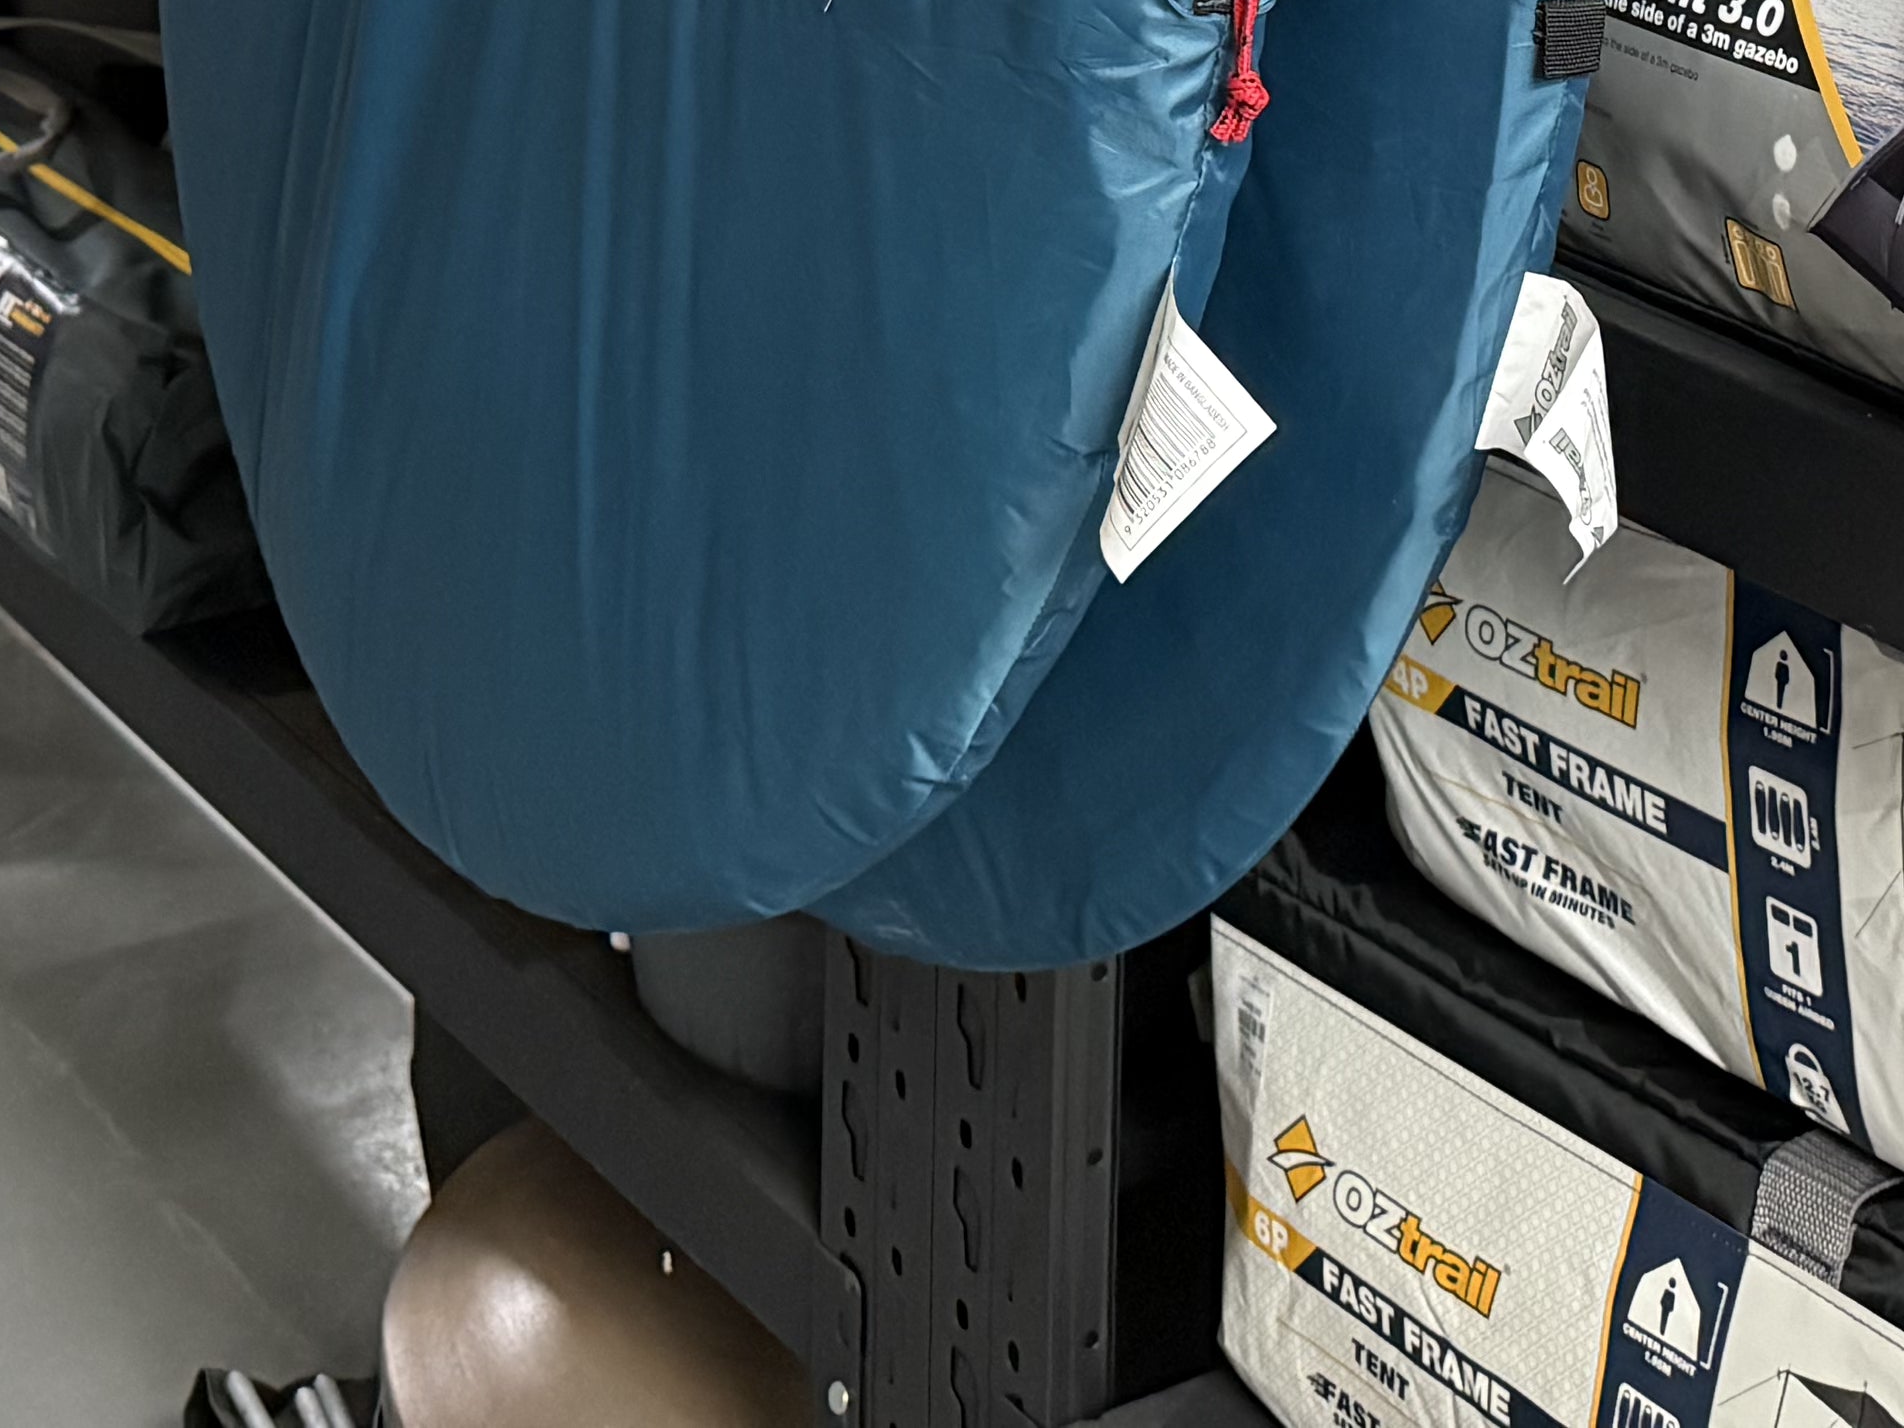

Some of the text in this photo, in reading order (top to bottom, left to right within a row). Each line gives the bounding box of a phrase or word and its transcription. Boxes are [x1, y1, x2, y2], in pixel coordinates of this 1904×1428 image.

[1631, 0, 1798, 74] side of a 3m gazebo
[1465, 604, 1640, 730] OZtrail
[1463, 695, 1668, 836] FAST FRAME
[1501, 771, 1564, 825] TENT
[1542, 855, 1637, 926] FRAME
[1547, 891, 1616, 930] MINUTES
[1785, 939, 1802, 978] 1
[1333, 1169, 1502, 1319] OZtrail
[1253, 1210, 1512, 1427] 6P FAST FRAME
[1351, 1338, 1410, 1403] TENT
